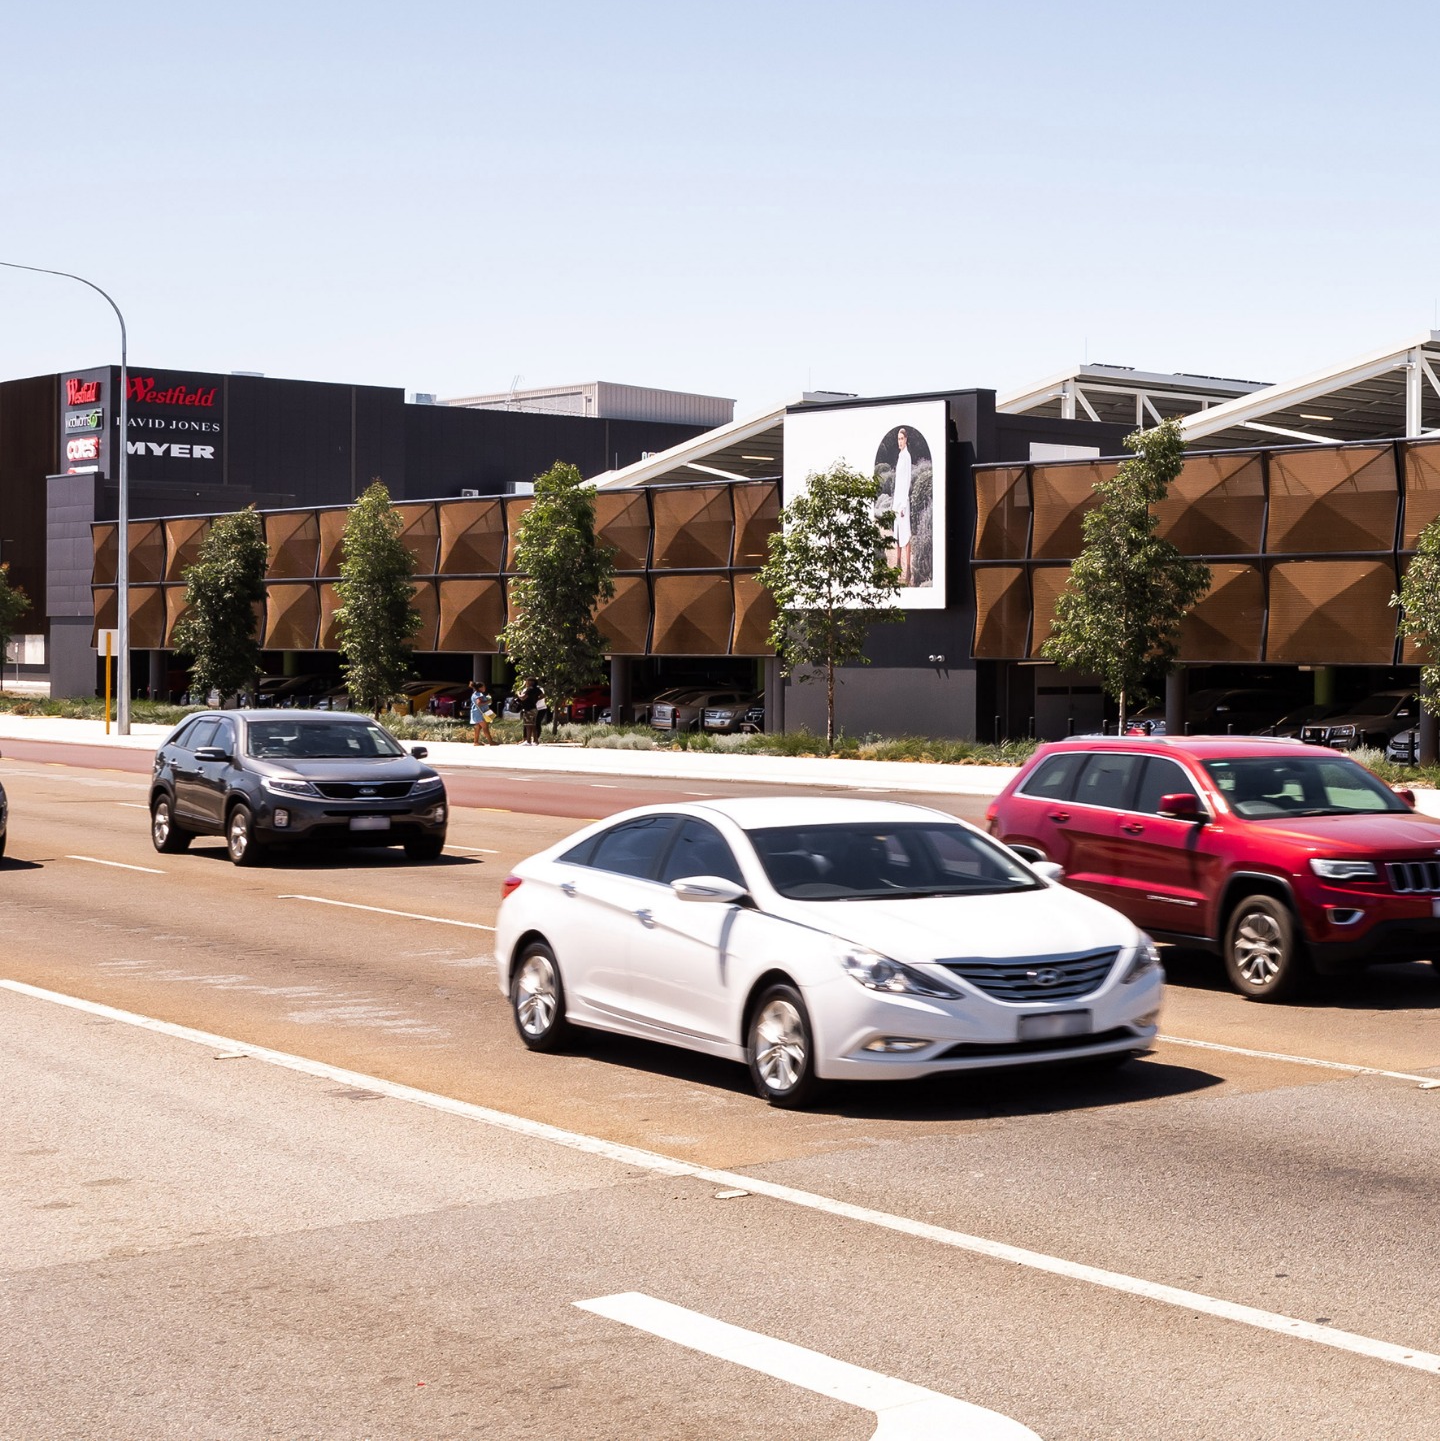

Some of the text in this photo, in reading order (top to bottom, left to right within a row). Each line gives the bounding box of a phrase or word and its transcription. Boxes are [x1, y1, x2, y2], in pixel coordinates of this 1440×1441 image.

[66, 378, 99, 406] Westfield
[117, 375, 218, 407] Westfield
[169, 420, 221, 433] JONES
[126, 440, 215, 460] MYER
